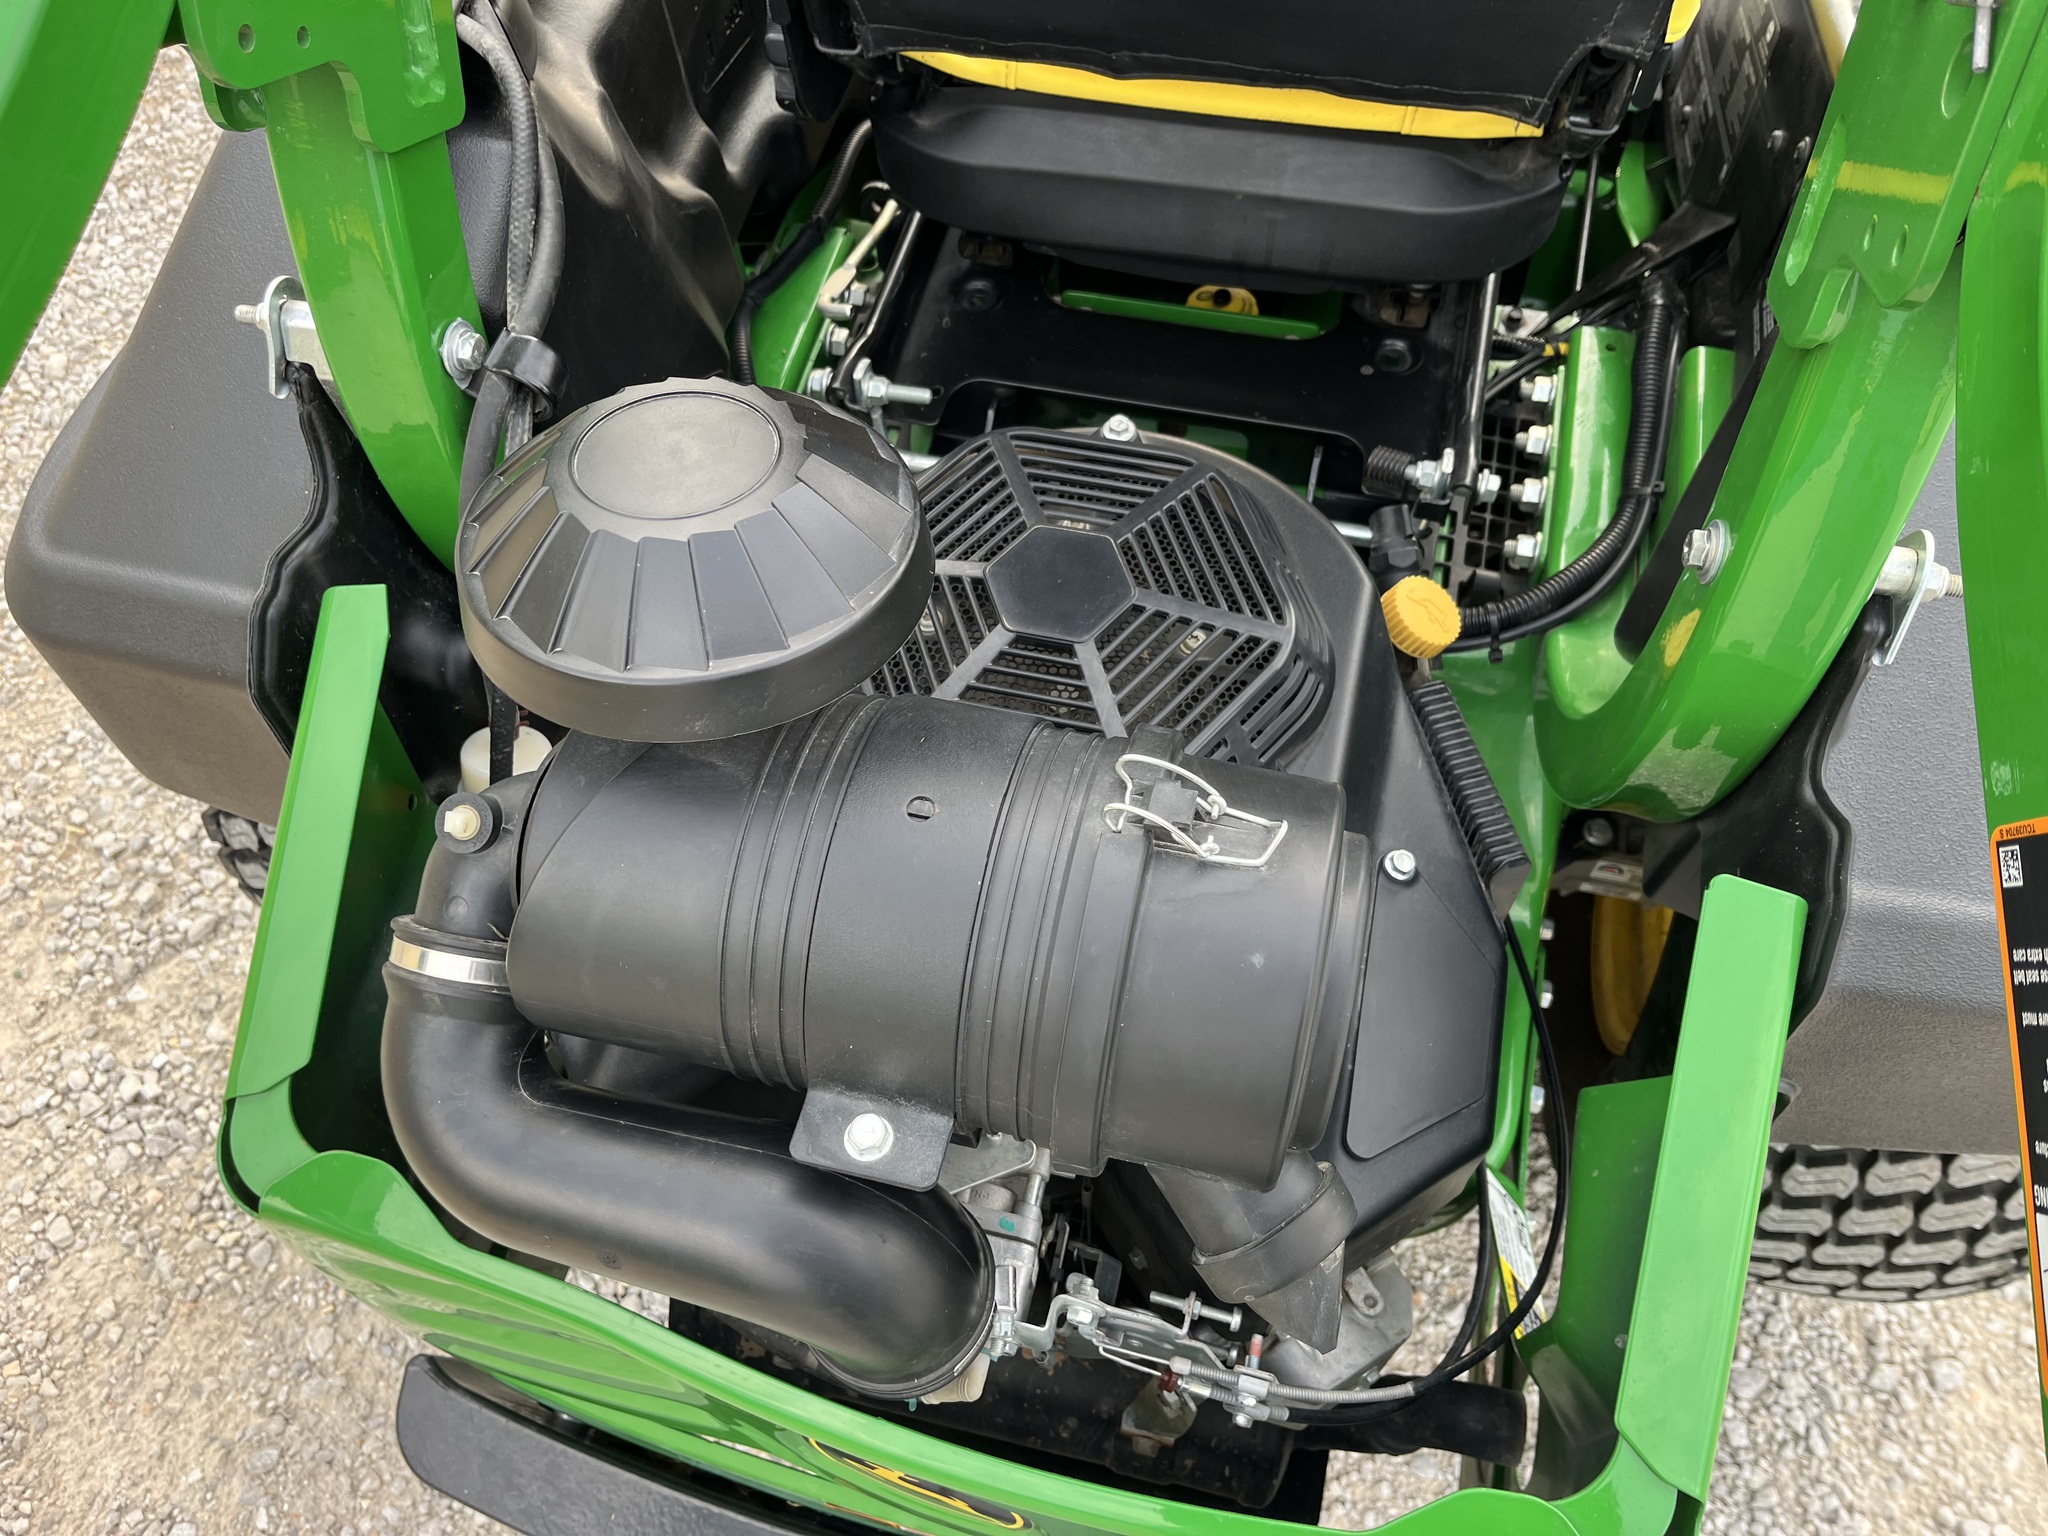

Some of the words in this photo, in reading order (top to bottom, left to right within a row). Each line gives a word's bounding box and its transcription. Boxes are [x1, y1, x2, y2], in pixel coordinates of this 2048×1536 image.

[2012, 948, 2026, 962] care
[2026, 948, 2043, 965] extra
[2013, 969, 2026, 986] belt
[2026, 969, 2040, 986] seat
[2021, 1011, 2038, 1028] must
